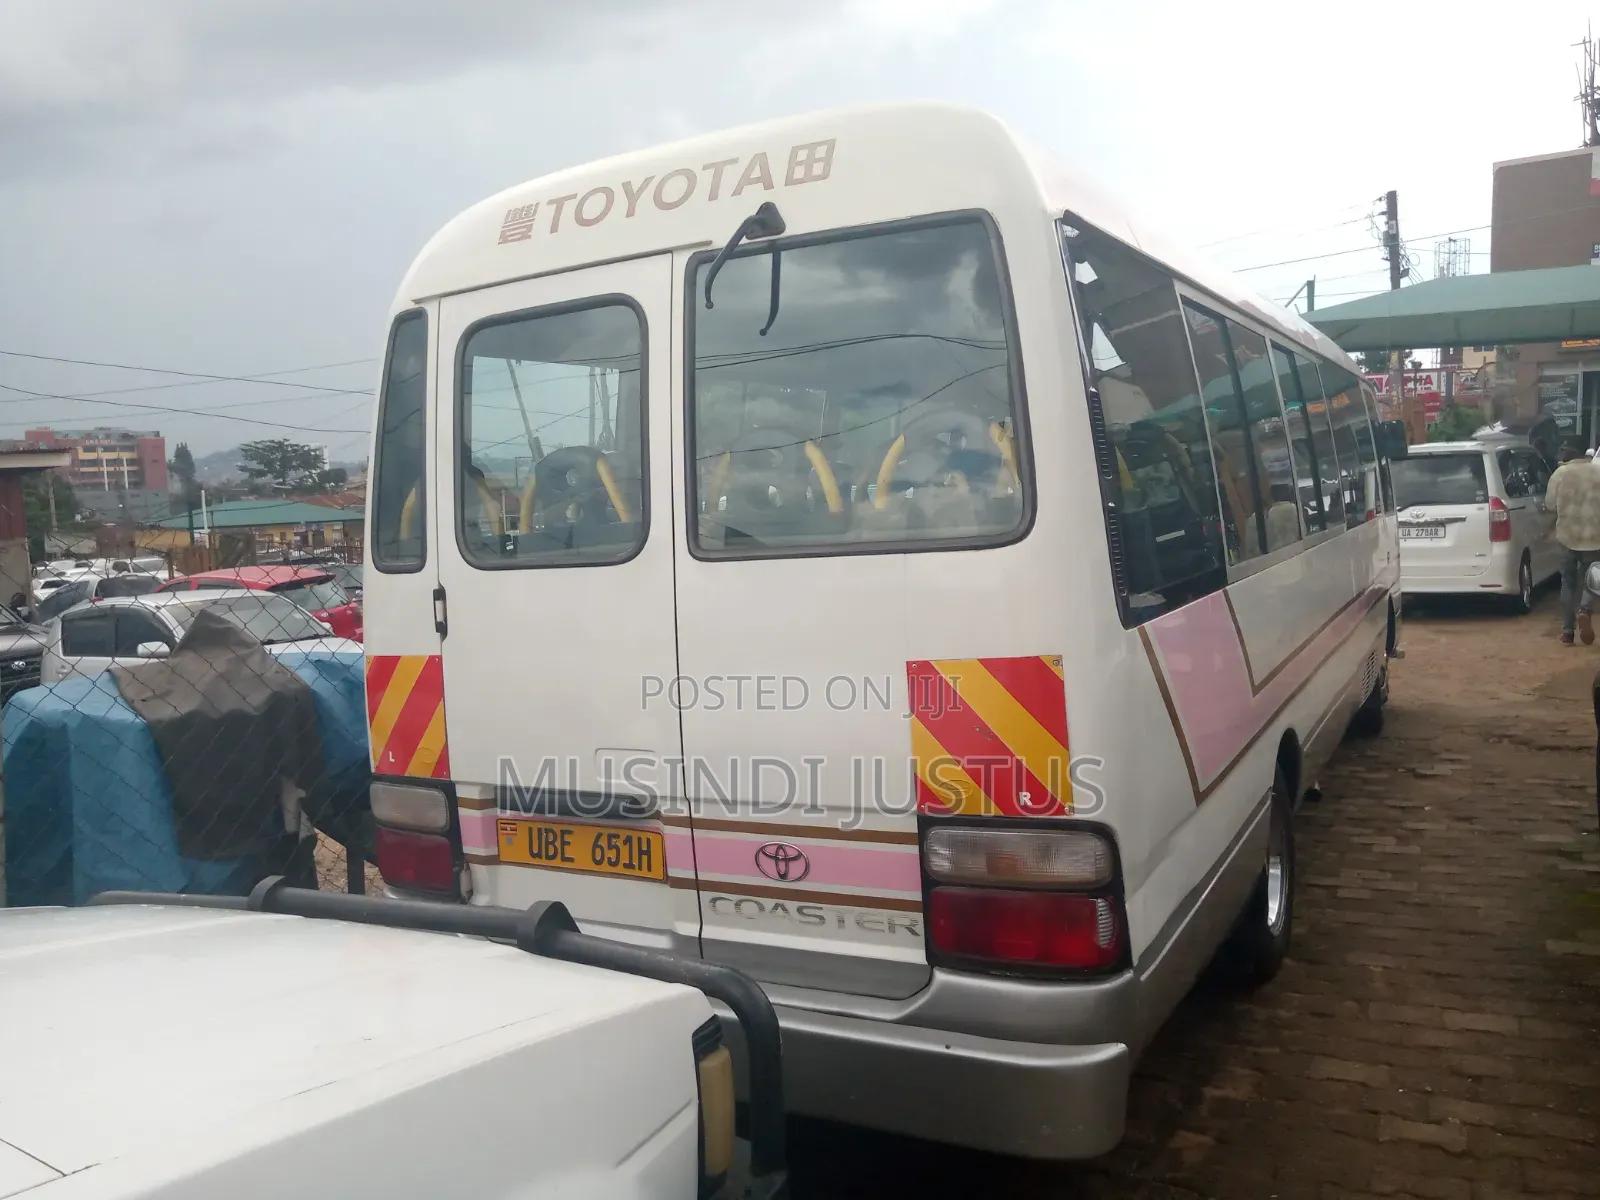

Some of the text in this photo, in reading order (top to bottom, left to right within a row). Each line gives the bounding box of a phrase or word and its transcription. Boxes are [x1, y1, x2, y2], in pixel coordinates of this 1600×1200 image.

[546, 152, 775, 235] TOYOTA
[1401, 528, 1411, 537] UA
[388, 750, 395, 763] L
[1019, 791, 1032, 806] R
[528, 826, 652, 872] UBE 651H
[709, 896, 921, 937] COASTER
